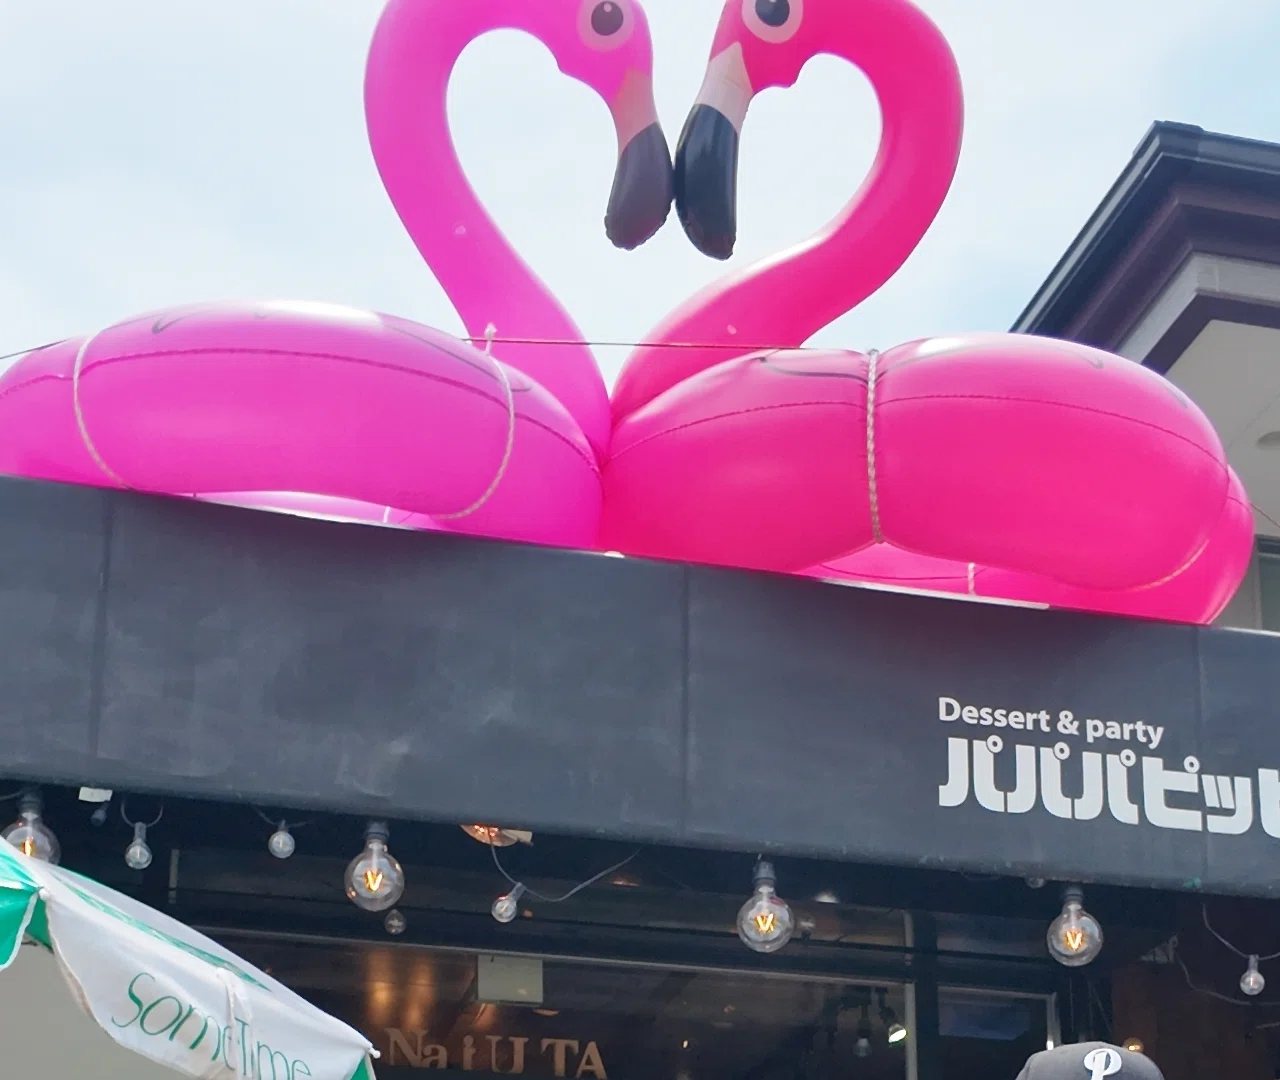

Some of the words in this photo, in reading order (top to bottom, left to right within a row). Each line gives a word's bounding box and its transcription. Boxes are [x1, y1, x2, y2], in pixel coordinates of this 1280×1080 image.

[938, 697, 1051, 733] Dessert
[1057, 710, 1080, 736] &
[1086, 717, 1165, 749] party
